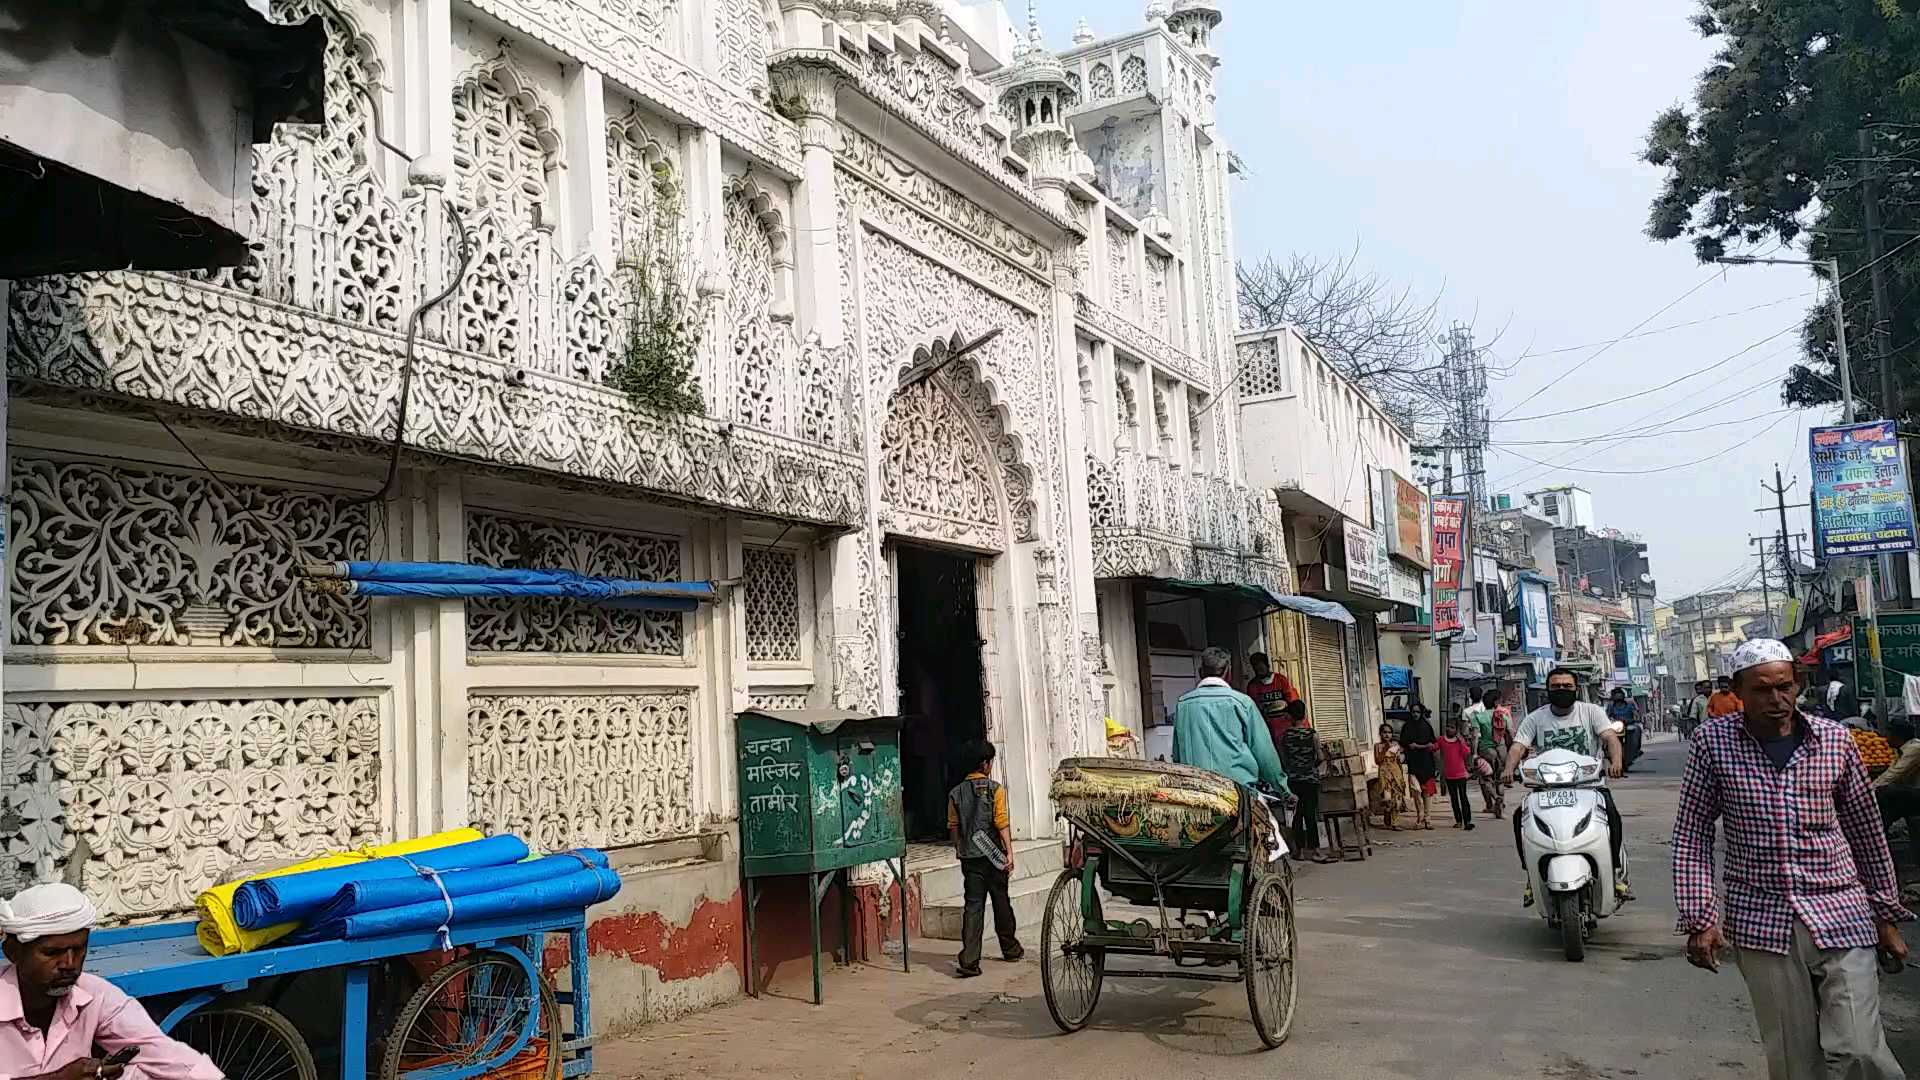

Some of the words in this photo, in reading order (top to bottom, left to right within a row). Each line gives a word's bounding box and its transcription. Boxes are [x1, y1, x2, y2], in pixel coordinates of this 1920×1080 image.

[745, 737, 792, 755] चन्दा
[746, 756, 801, 783] मस्जिद
[748, 783, 800, 813] तामीर
